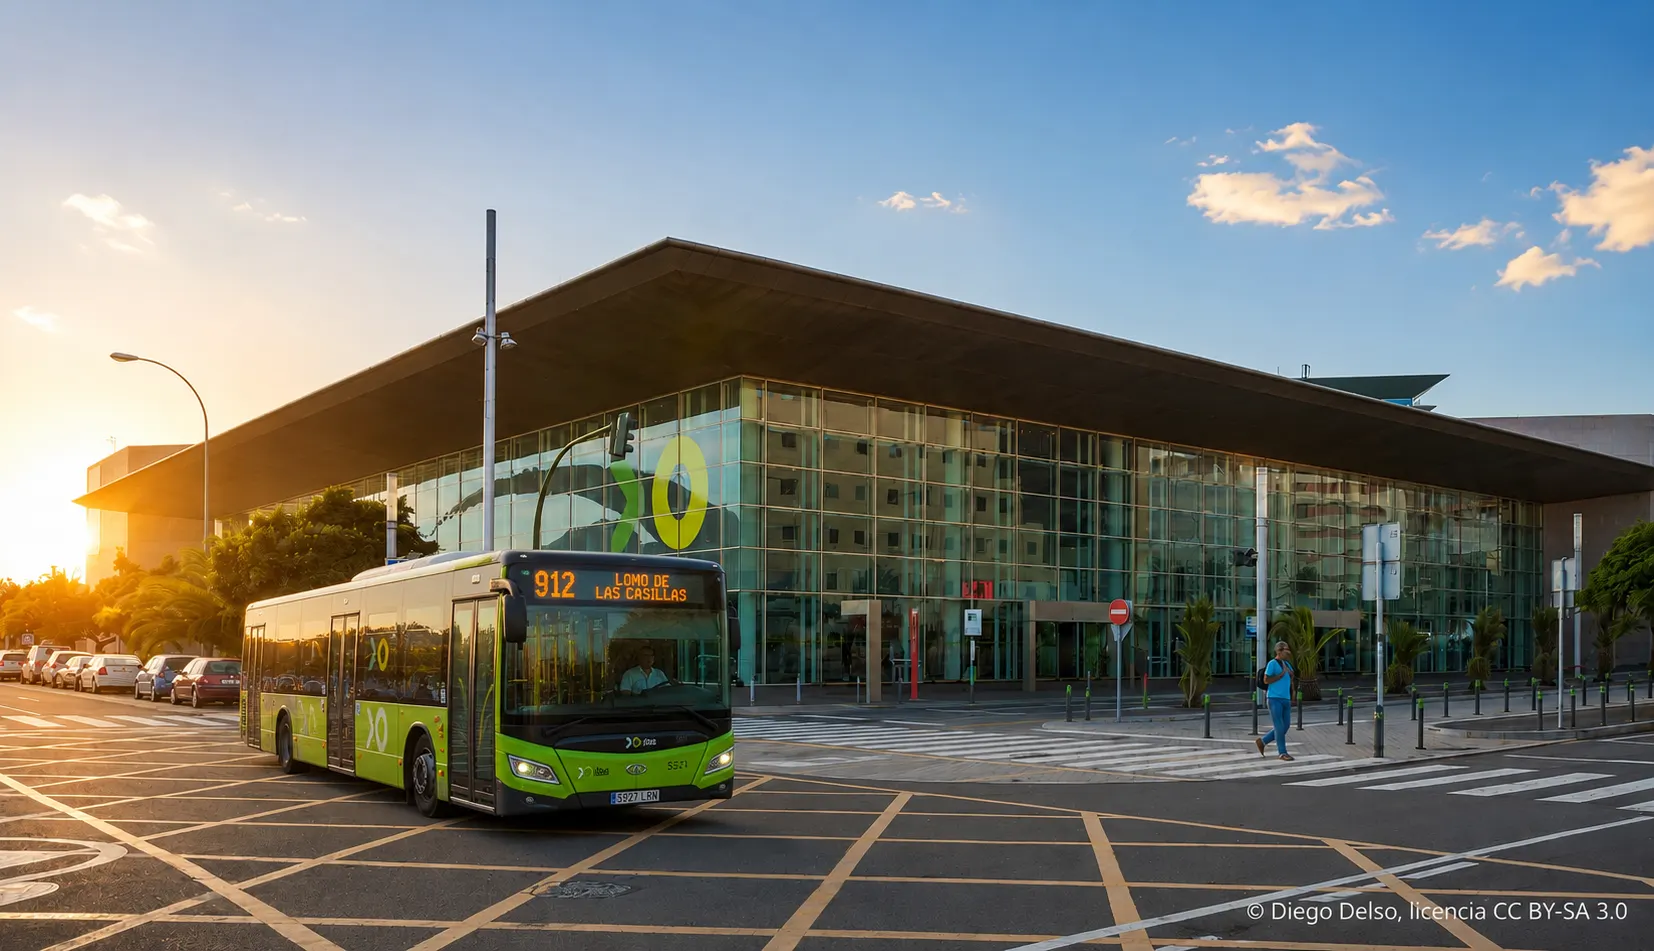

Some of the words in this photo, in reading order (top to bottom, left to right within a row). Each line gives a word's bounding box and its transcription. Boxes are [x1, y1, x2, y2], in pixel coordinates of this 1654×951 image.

[535, 570, 575, 598] 912
[615, 573, 649, 587] LOMO
[654, 574, 670, 588] DE
[595, 586, 621, 600] LAS
[625, 587, 687, 602] CASILLAS
